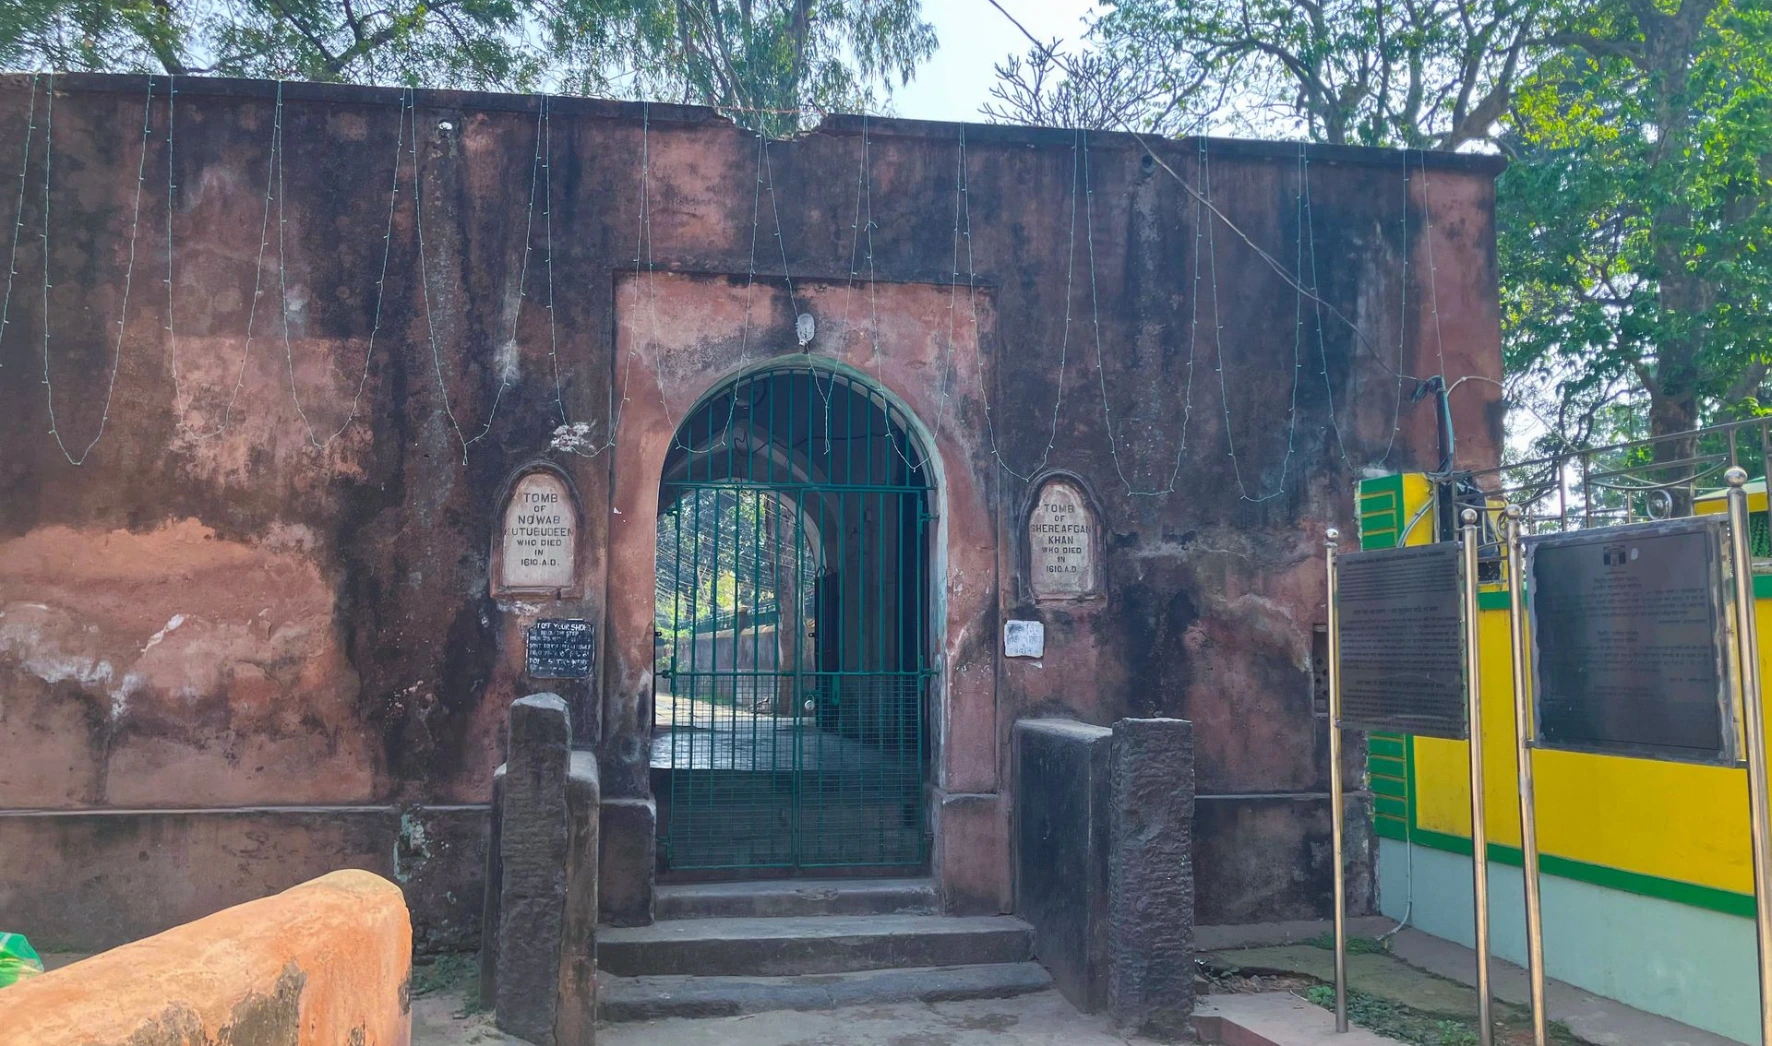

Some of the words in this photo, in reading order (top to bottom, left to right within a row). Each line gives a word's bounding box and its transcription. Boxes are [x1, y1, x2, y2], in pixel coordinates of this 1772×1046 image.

[523, 493, 559, 503] TOMB
[533, 505, 547, 513] OF
[1043, 504, 1075, 513] TOMB
[518, 514, 561, 525] NOWAB
[1054, 514, 1065, 522] OF
[504, 528, 573, 537] UTUBUDEEN
[1048, 535, 1074, 545] KHAN
[1042, 546, 1060, 554] WHO
